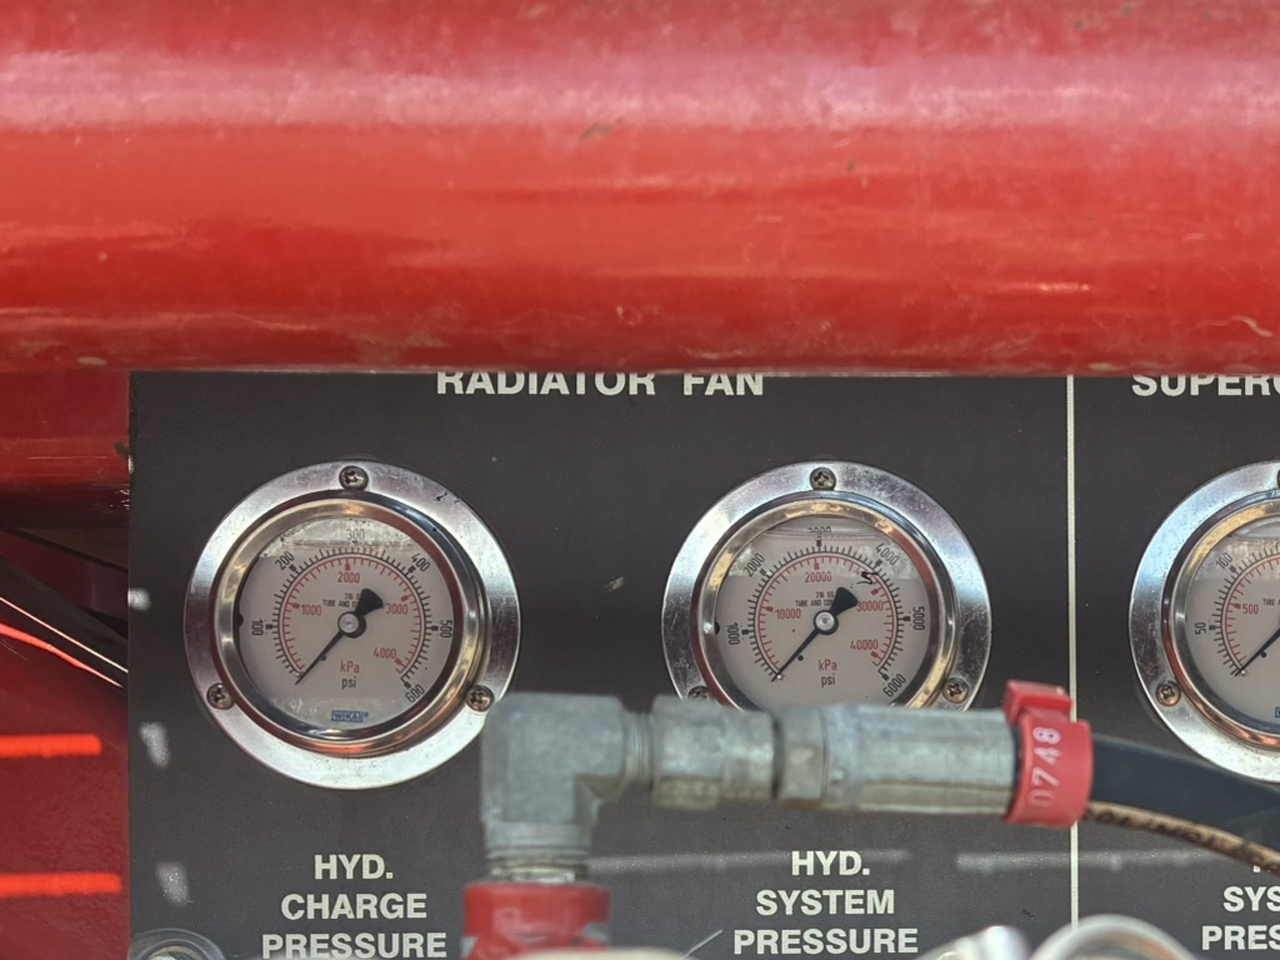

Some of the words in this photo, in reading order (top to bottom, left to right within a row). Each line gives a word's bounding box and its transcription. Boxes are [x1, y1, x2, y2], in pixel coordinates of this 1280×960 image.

[436, 371, 656, 396] RADIATOR
[683, 371, 764, 396] FAN
[275, 551, 295, 570] 200
[411, 553, 431, 572] 400
[876, 543, 899, 565] 4000
[1215, 552, 1233, 570] 100
[743, 553, 766, 578] 2000
[337, 573, 360, 583] 2000
[804, 572, 832, 583] 20000
[301, 605, 322, 616] 1000
[386, 604, 408, 615] 3000
[775, 609, 802, 619] 10000
[856, 601, 884, 612] 30000
[1242, 604, 1259, 615] 500
[251, 619, 264, 636] 100
[912, 606, 925, 631] 5000
[440, 619, 453, 638] 500
[727, 622, 741, 646] 1000
[1195, 622, 1207, 635] 50
[373, 648, 397, 659] 4000
[850, 639, 878, 650] 40000
[339, 661, 360, 673] kPa
[818, 659, 838, 671] kPa
[341, 676, 357, 691] psi
[821, 674, 836, 688] psi
[882, 673, 907, 698] 6000
[405, 684, 425, 703] 600
[314, 854, 394, 880] HYD.
[791, 850, 870, 876] HYD.
[280, 892, 427, 921] CHARGE
[756, 889, 895, 916] SYSTEM
[262, 932, 447, 960] PRESSURE
[734, 928, 919, 955] PRESSURE
